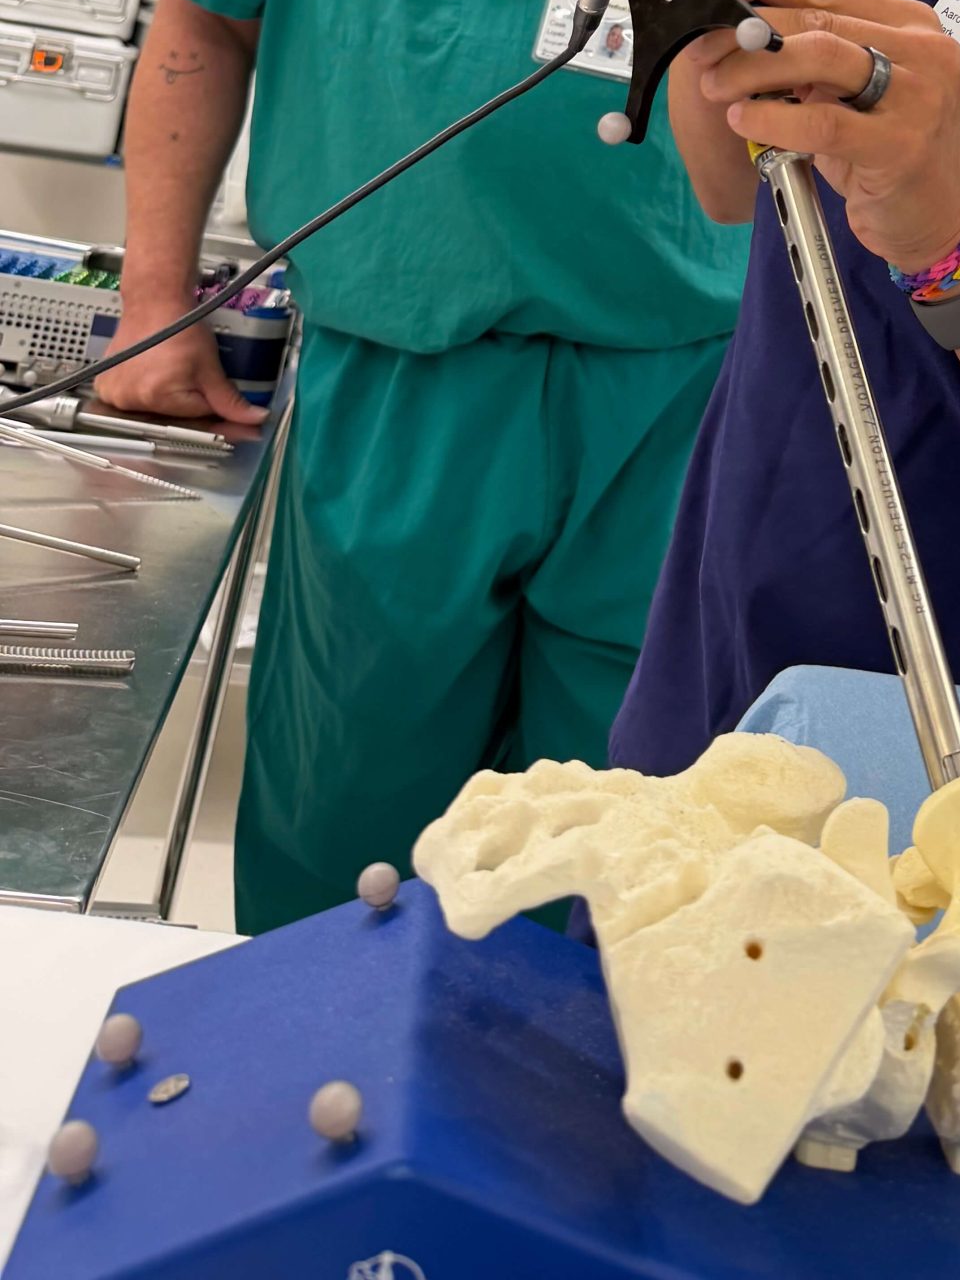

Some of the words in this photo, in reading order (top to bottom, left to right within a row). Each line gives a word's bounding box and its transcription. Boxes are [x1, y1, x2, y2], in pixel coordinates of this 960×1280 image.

[826, 278, 848, 334] DRIVER
[843, 340, 871, 412] VOYAGER
[868, 434, 904, 532] REDUCTION
